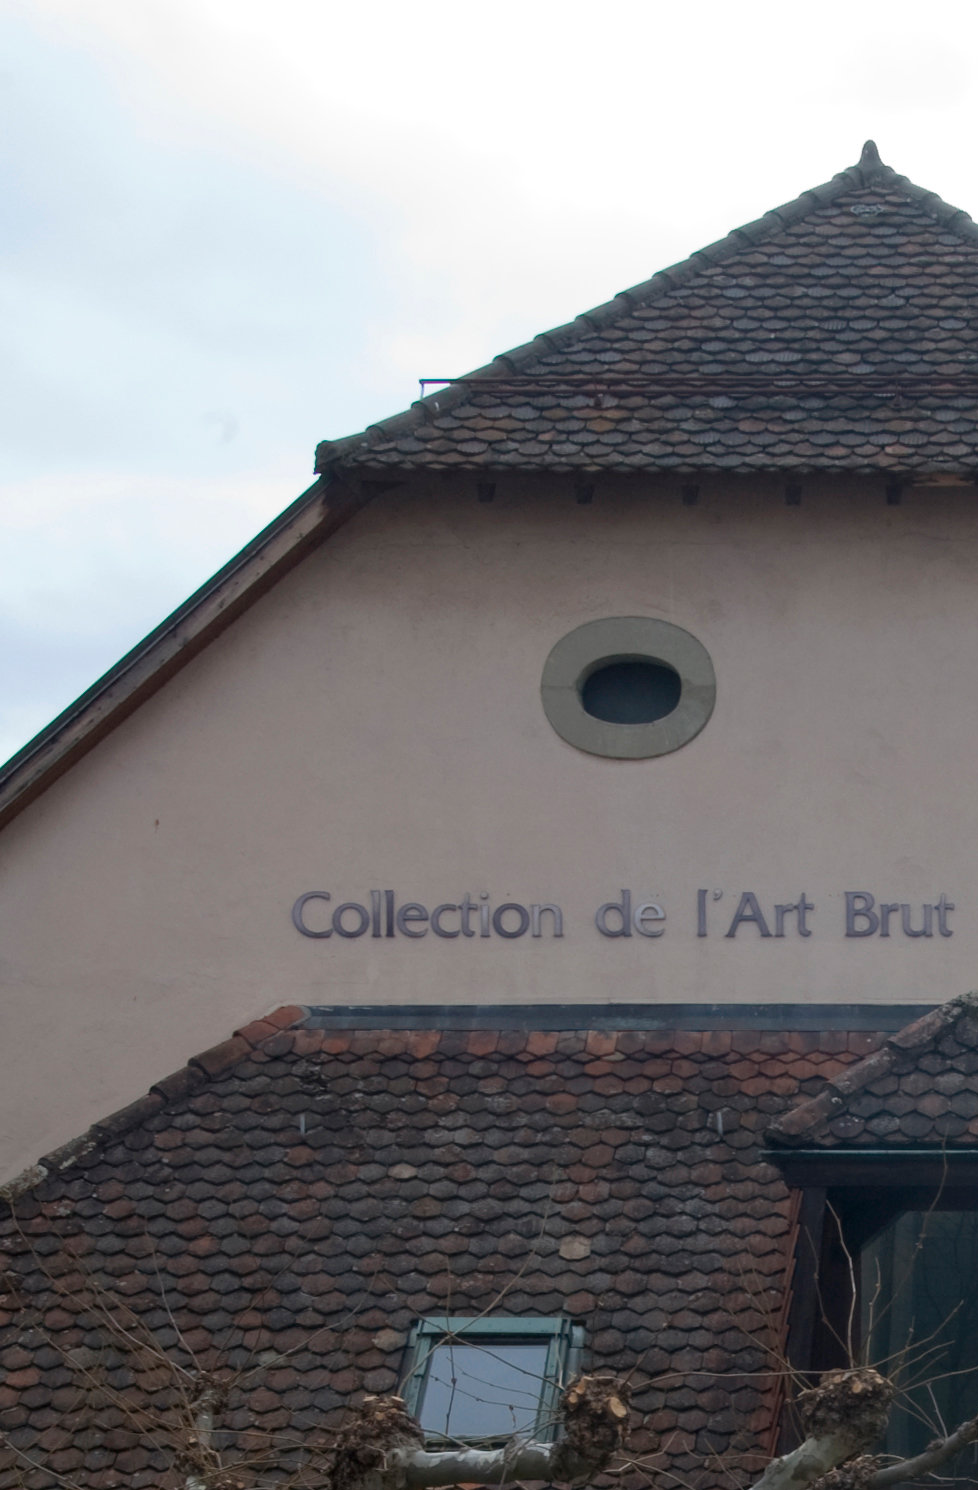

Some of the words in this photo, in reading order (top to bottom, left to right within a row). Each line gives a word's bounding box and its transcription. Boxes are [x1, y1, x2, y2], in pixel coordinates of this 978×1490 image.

[291, 889, 564, 939] Collection
[594, 889, 667, 939] de
[695, 888, 812, 939] l'Art
[843, 890, 956, 939] Brut
